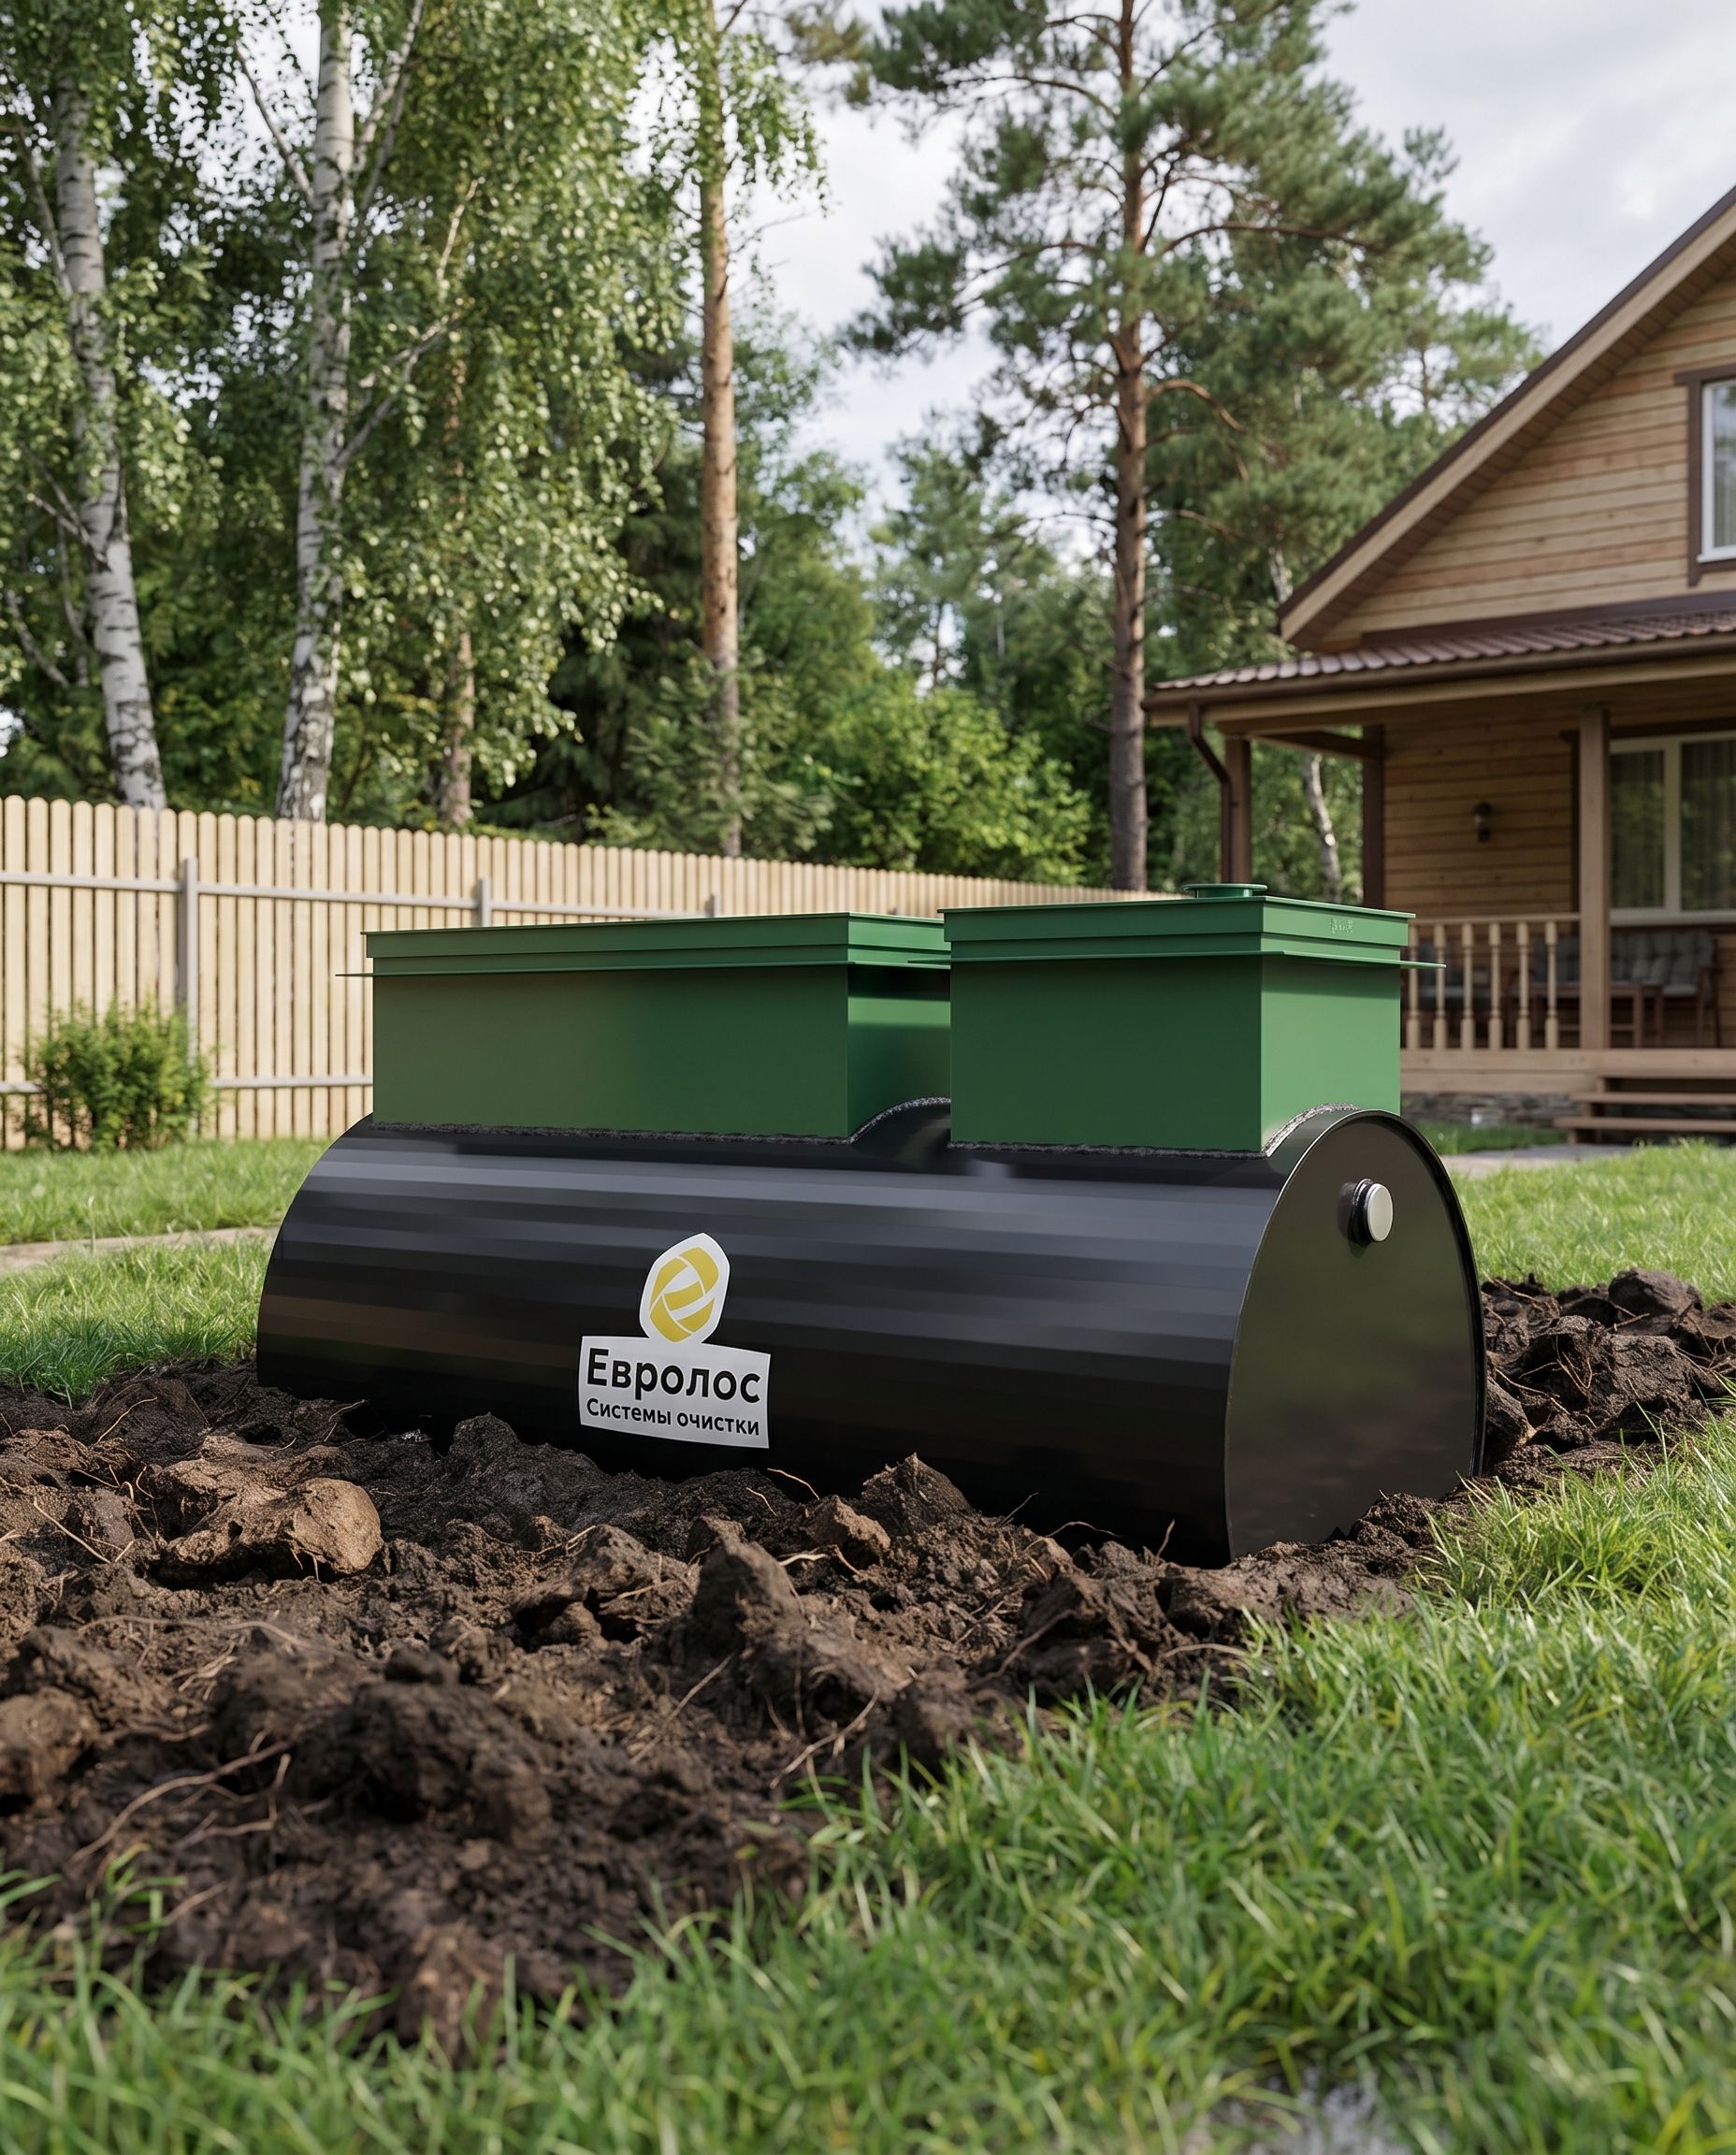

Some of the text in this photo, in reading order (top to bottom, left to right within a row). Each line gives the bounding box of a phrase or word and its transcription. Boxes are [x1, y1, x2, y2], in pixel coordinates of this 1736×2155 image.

[587, 1348, 760, 1403] Евролос
[586, 1398, 760, 1436] Системы очистки
